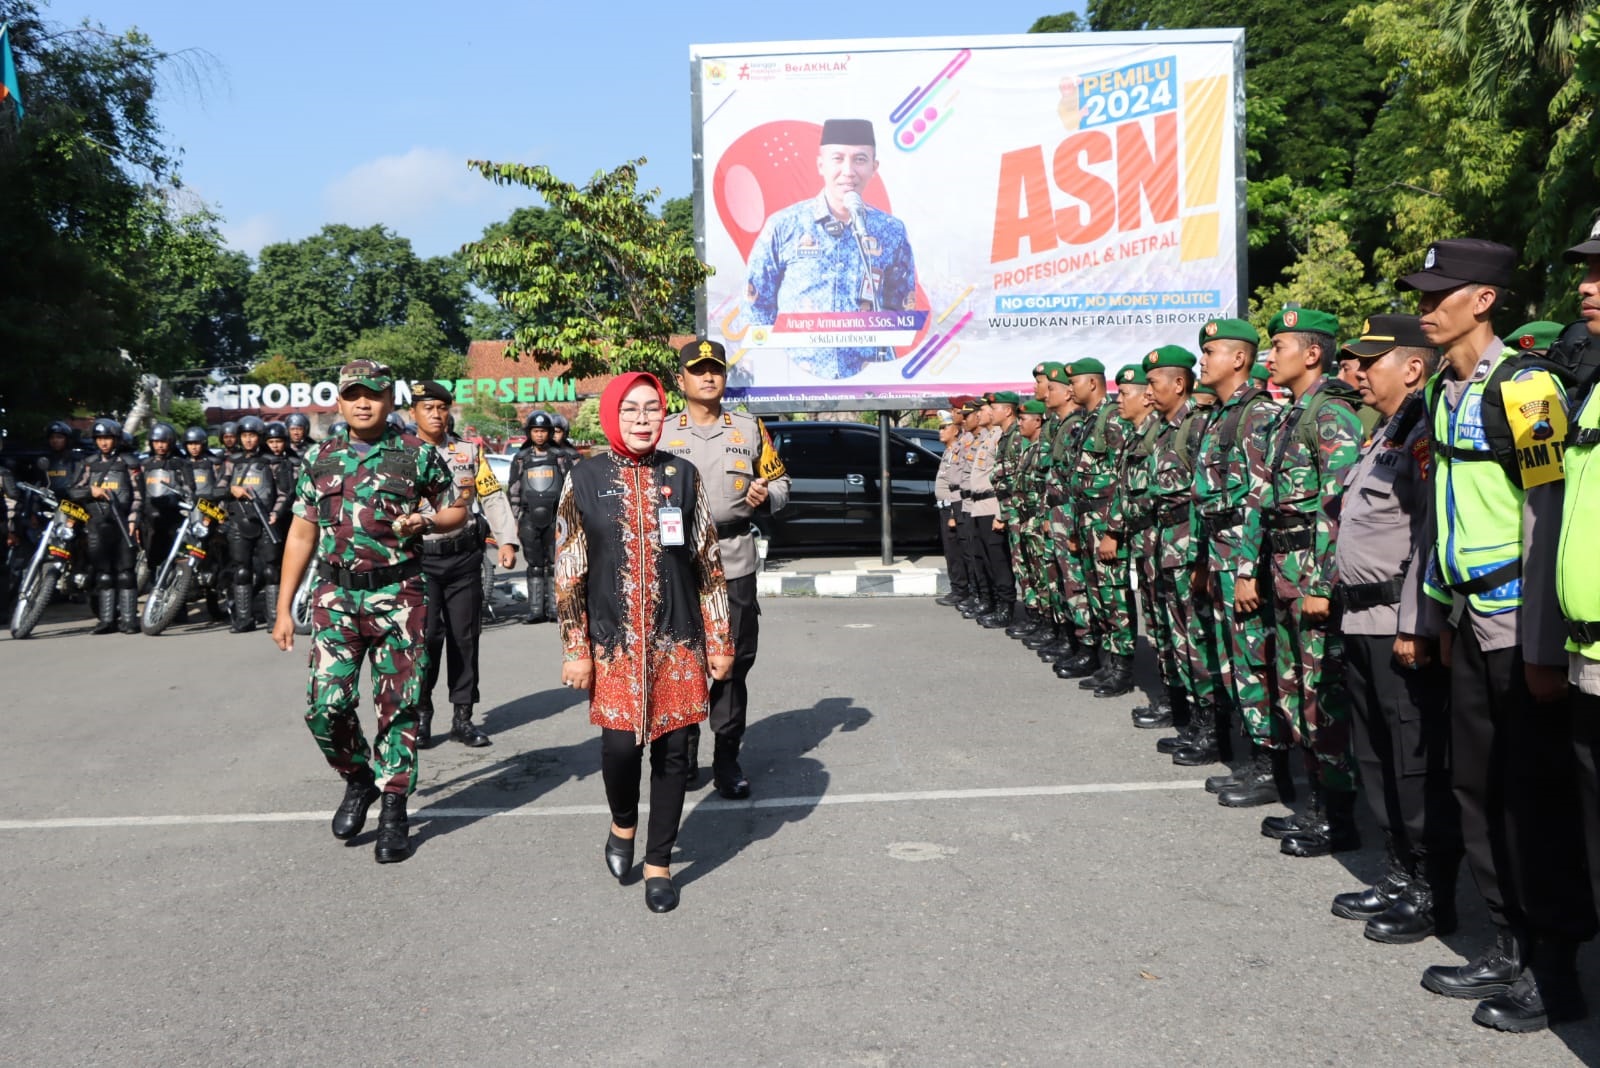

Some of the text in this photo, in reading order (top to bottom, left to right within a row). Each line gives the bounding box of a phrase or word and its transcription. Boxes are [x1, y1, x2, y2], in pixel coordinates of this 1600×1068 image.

[785, 61, 848, 72] BerAKHLAK
[1083, 60, 1170, 96] PEMILU
[1086, 80, 1172, 125] 2024
[994, 232, 1179, 290] PROFESIONAL & NETRAL
[1001, 292, 1214, 310] NO GOLPUT, NO MONEY POLITIC
[786, 318, 814, 329] Anang
[988, 311, 1228, 328] WUJUDKAN NETRALITAS BIROKRASI
[214, 380, 418, 409] GROBON
[725, 446, 751, 456] POLRI
[1518, 443, 1551, 470] PAM
